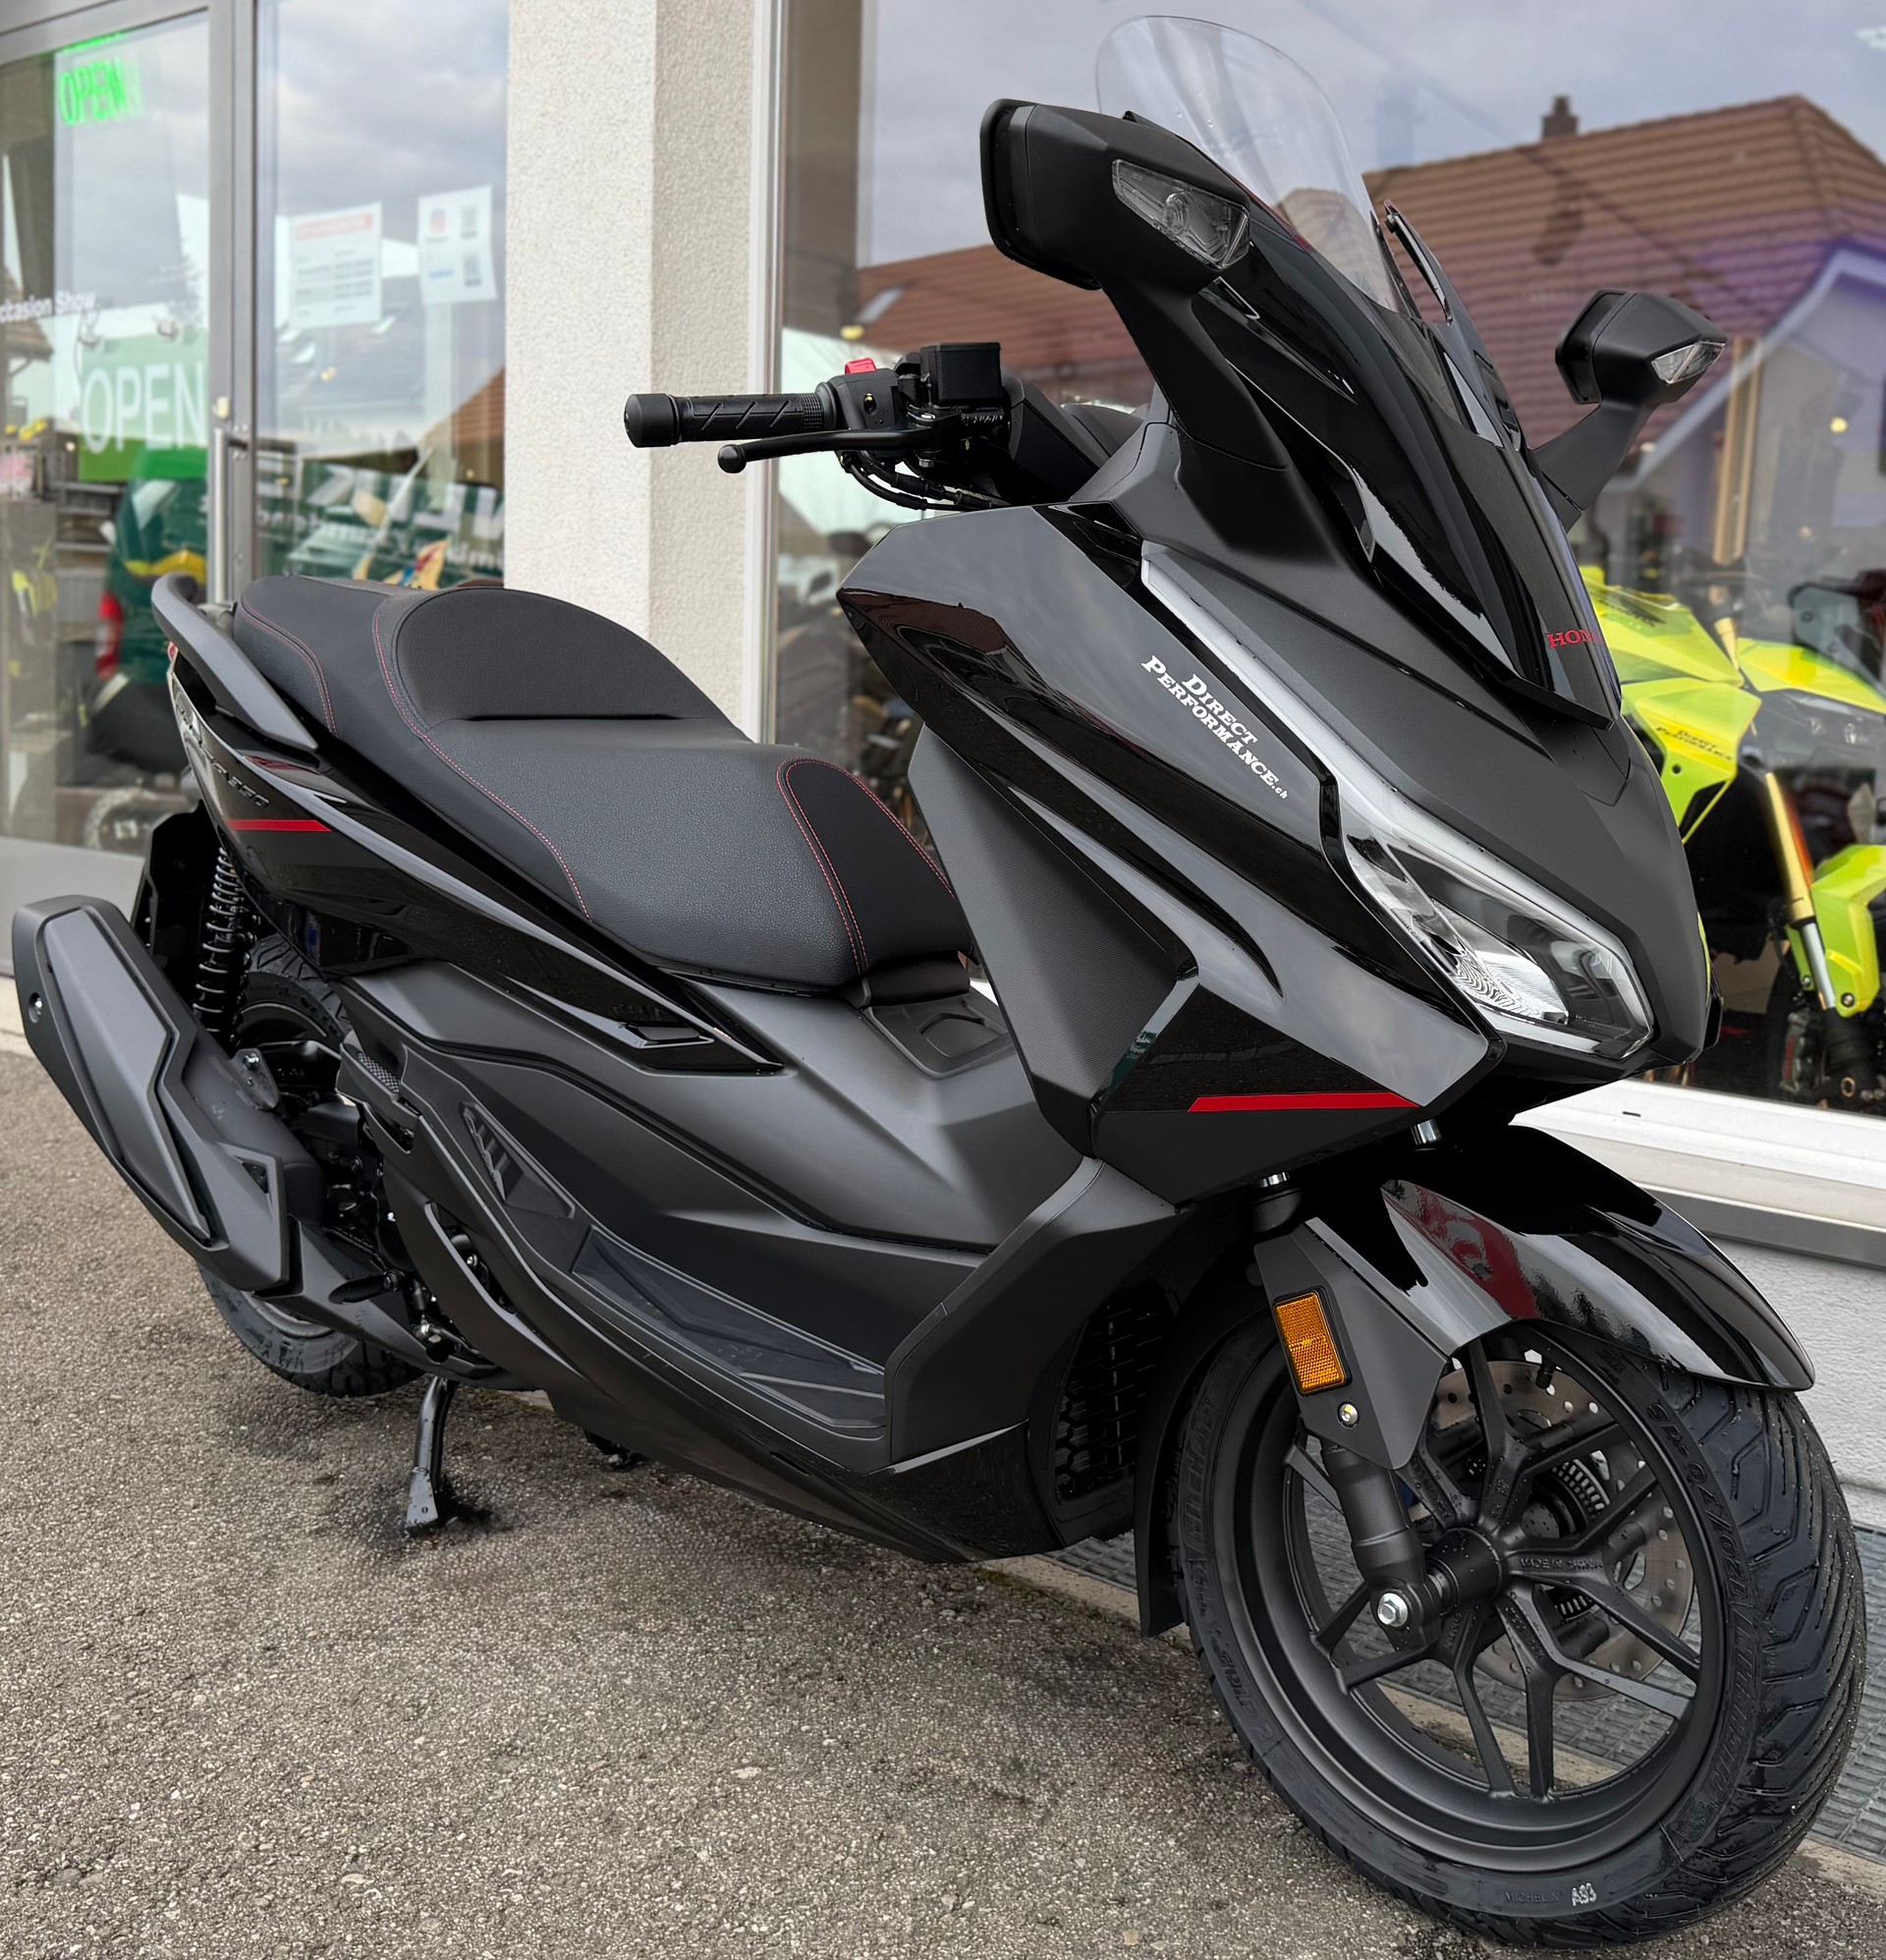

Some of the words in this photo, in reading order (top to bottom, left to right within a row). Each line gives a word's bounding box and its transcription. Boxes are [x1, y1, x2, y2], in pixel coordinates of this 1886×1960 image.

[60, 57, 127, 126] OPEN
[82, 362, 205, 454] OPEN
[1182, 673, 1257, 745] DIRECT
